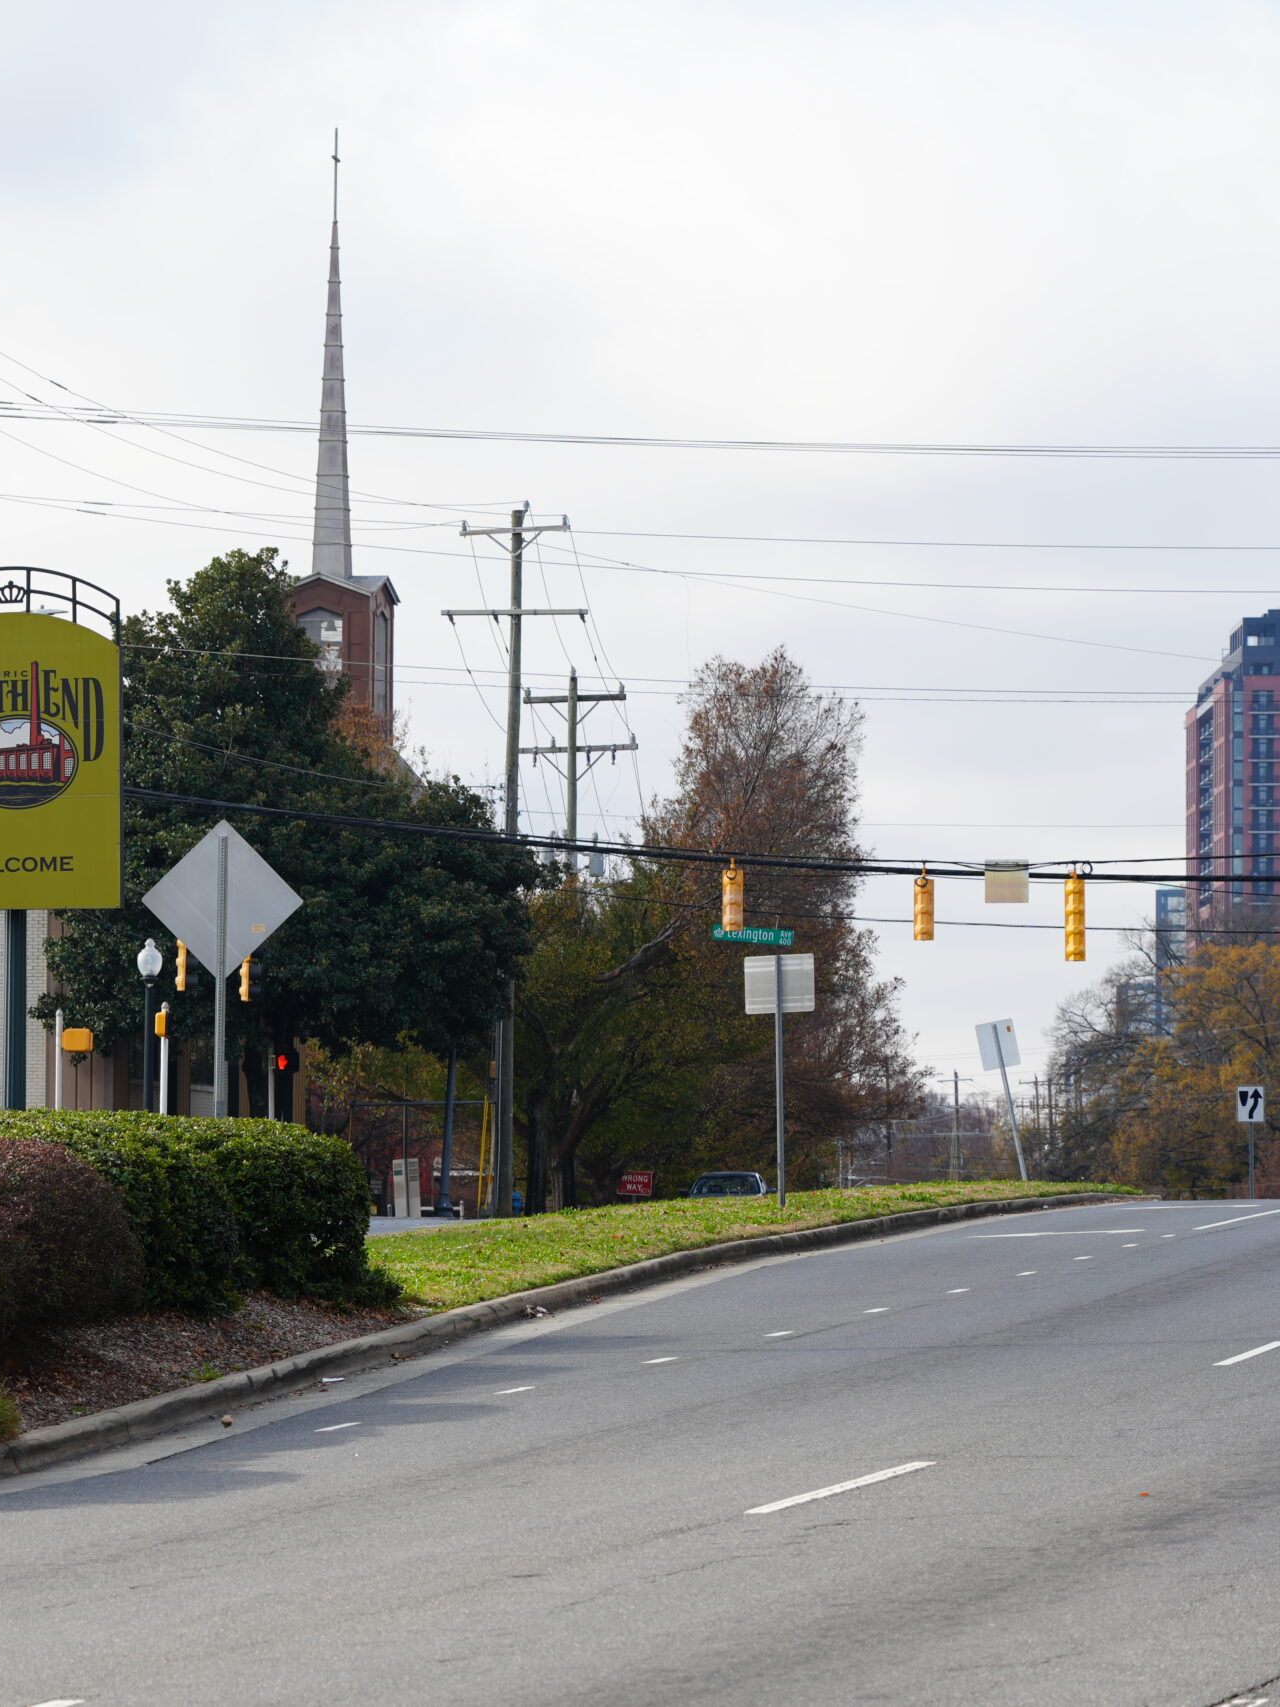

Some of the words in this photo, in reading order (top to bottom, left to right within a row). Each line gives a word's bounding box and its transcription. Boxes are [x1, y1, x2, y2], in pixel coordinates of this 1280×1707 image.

[41, 669, 105, 763] END
[780, 930, 792, 938] Ave
[779, 938, 792, 946] 400
[626, 1183, 643, 1191] WAY
